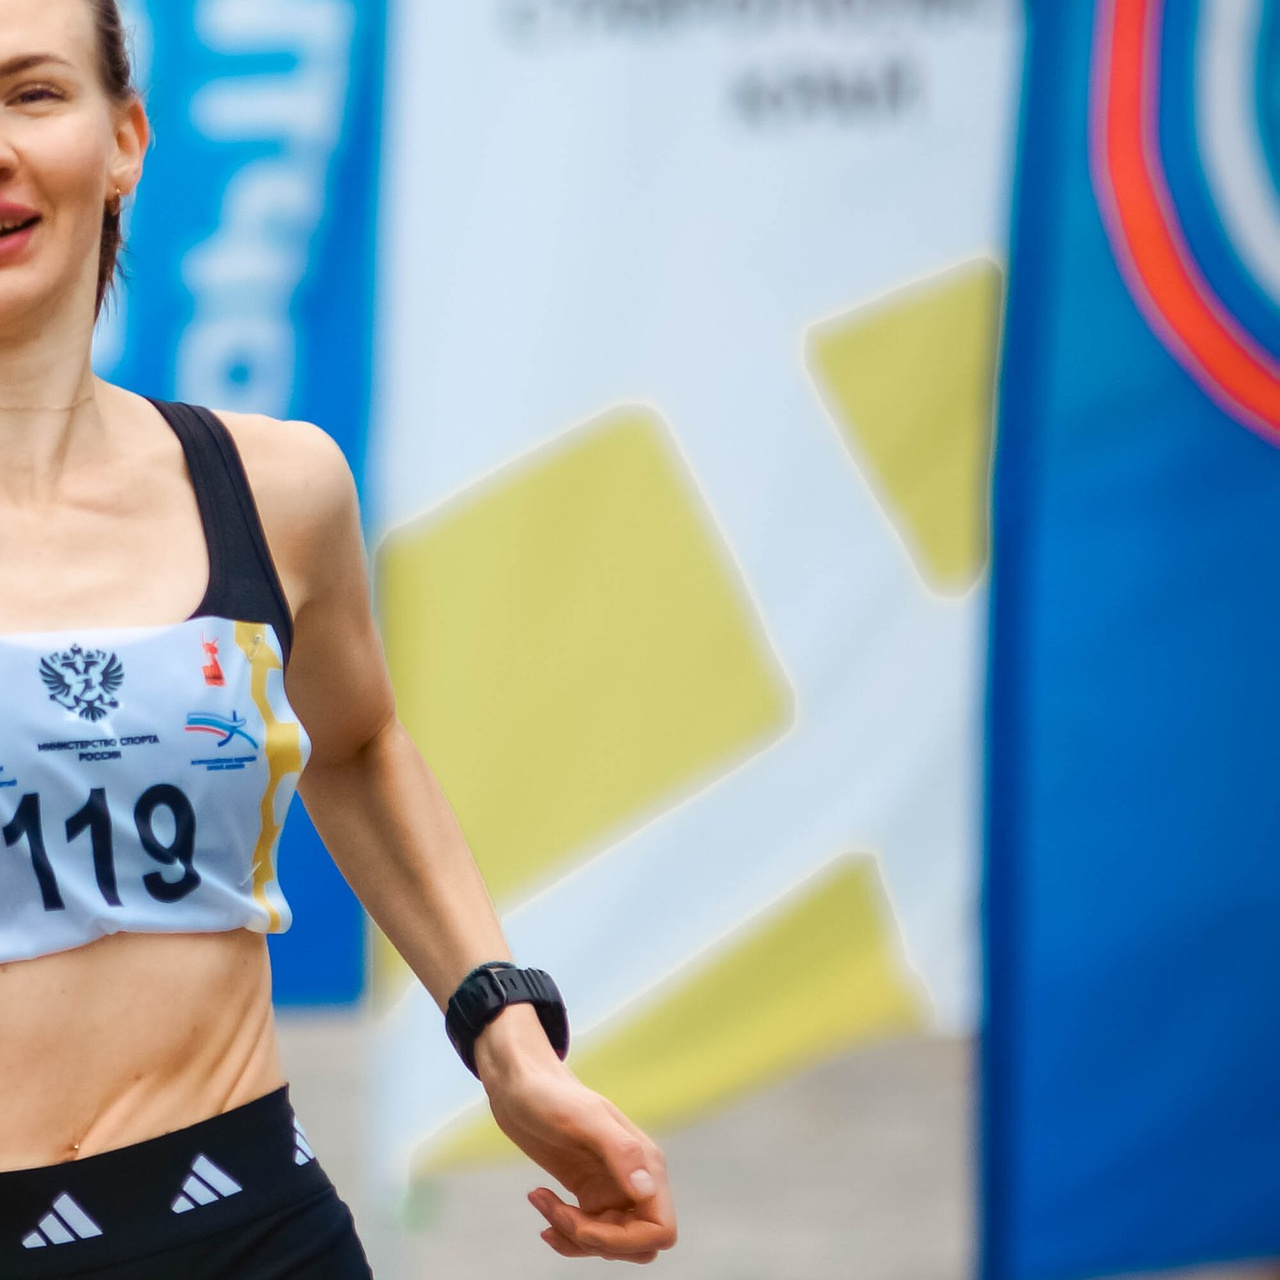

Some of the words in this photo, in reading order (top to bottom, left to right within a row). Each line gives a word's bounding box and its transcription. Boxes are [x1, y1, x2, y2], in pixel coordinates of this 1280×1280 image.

[37, 738, 118, 751] МИНИСТЕРСТВО
[120, 734, 160, 746] СПОРТА
[78, 750, 122, 762] РОССИИ
[2, 783, 202, 912] 119
